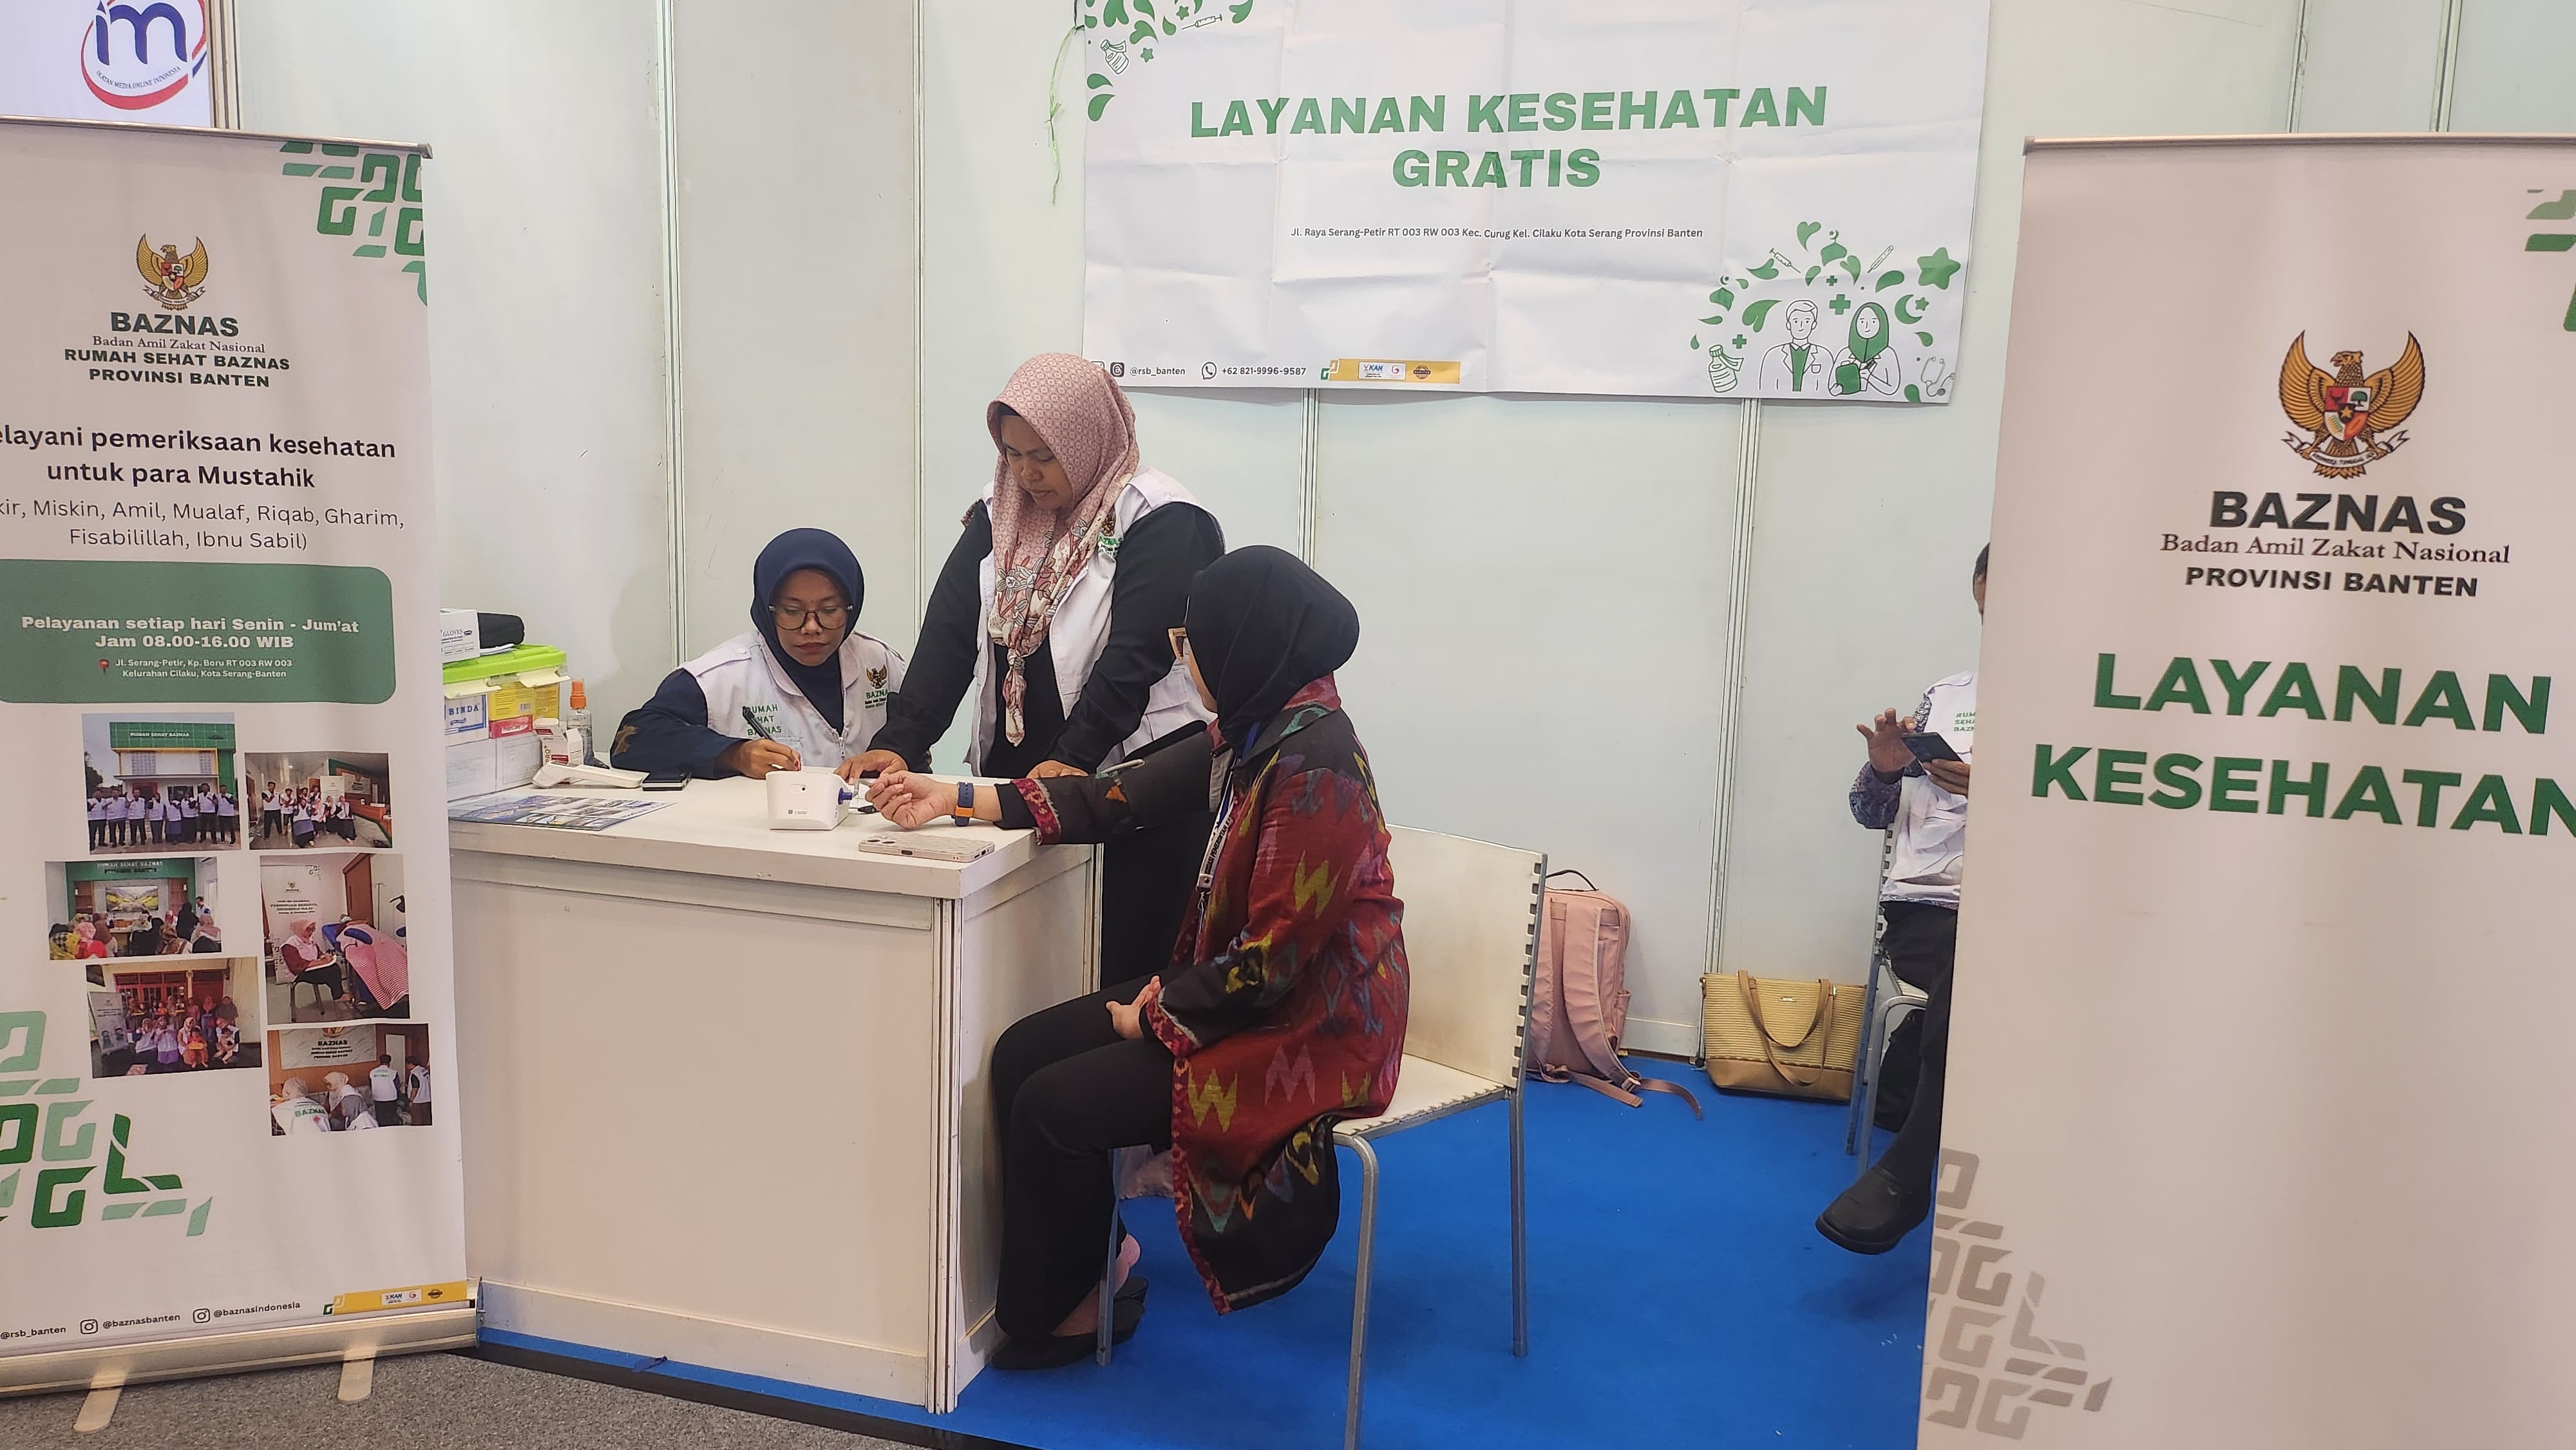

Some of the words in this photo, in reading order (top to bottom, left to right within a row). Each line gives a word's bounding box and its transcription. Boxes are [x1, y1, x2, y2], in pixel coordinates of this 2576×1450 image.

[97, 70, 113, 86] IKATAN
[133, 80, 153, 89] ONLINE
[154, 66, 181, 84] INDONESIA
[1191, 95, 1445, 138] LAYANAN
[1467, 86, 1826, 133] KESEHATAN
[1392, 149, 1600, 188] GRATIS
[1291, 228, 1302, 236] Jl.
[1305, 228, 1326, 238] Raya
[1328, 228, 1386, 238] Serang-Petir
[1388, 228, 1401, 236] RT
[1402, 228, 1421, 236] 003
[1423, 228, 1438, 236] RW
[1441, 228, 1459, 236] 003
[1462, 228, 1482, 238] Kec.
[1484, 229, 1510, 240] Curug
[1513, 229, 1531, 238] Kel.
[1533, 229, 1562, 238] Cilaku
[1564, 229, 1586, 238] Kota
[1588, 229, 1622, 240] Serang
[1625, 229, 1665, 238] Provinsi
[1667, 229, 1703, 238] Banten
[111, 312, 239, 337] BAZNAS
[92, 336, 133, 348] Badan
[137, 338, 166, 349] Amil
[170, 339, 206, 350] Zakat
[210, 341, 265, 353] Nasional
[64, 348, 136, 363] RUMAH
[144, 352, 207, 366] SEHAT
[214, 355, 290, 370] BAZNAS
[90, 368, 182, 384] PROVINSI
[190, 373, 269, 387] BANTEN
[1130, 367, 1186, 377] @rsb_banten
[1222, 367, 1238, 375] +62
[1240, 366, 1307, 375] 821-9996-9587
[91, 430, 260, 452] pemeriksaan
[269, 433, 395, 458] kesehatan
[47, 462, 124, 482] untuk
[132, 467, 191, 487] para
[198, 466, 315, 487] Mustahik
[33, 500, 105, 520] Miskin,
[112, 502, 166, 522] Amil,
[173, 503, 250, 523] Mualaf,
[258, 505, 319, 526] Riqab,
[325, 508, 404, 529] Gharim,
[2209, 491, 2467, 535] BAZNAS
[70, 529, 190, 550] Fisabilillah,
[197, 531, 242, 547] Ibnu
[250, 532, 308, 551] Sabil)
[1098, 536, 1123, 545] AZNAS
[2159, 534, 2239, 554] Badan
[2244, 536, 2304, 556] Amil
[2311, 538, 2385, 559] Zakat
[2393, 541, 2510, 563] Nasional
[2185, 567, 2331, 590] PROVINSI
[2344, 572, 2478, 597] BANTEN
[22, 616, 119, 632] Pelayanan
[126, 617, 185, 632] setiap
[191, 617, 225, 630] hari
[232, 618, 284, 630] Senin
[302, 619, 359, 632] Jum'at
[95, 635, 137, 647] Jam
[142, 635, 251, 648] 08.00-16.00
[256, 636, 294, 648] WIB
[128, 659, 185, 668] Serang-Petir,
[187, 659, 202, 668] Kp.
[169, 670, 199, 678] Cilaku,
[223, 670, 287, 679] Serang-Banten
[866, 688, 888, 699] BAZNA
[2092, 652, 2551, 735] LAYANAN
[752, 704, 778, 713] UMAH
[748, 726, 782, 736] BNAS
[2031, 744, 2576, 839] KESEHATAN
[214, 1301, 301, 1318] @baznasindonesia
[102, 1313, 180, 1329] @baznasbanten
[1, 1326, 66, 1339] @rsb_banten
